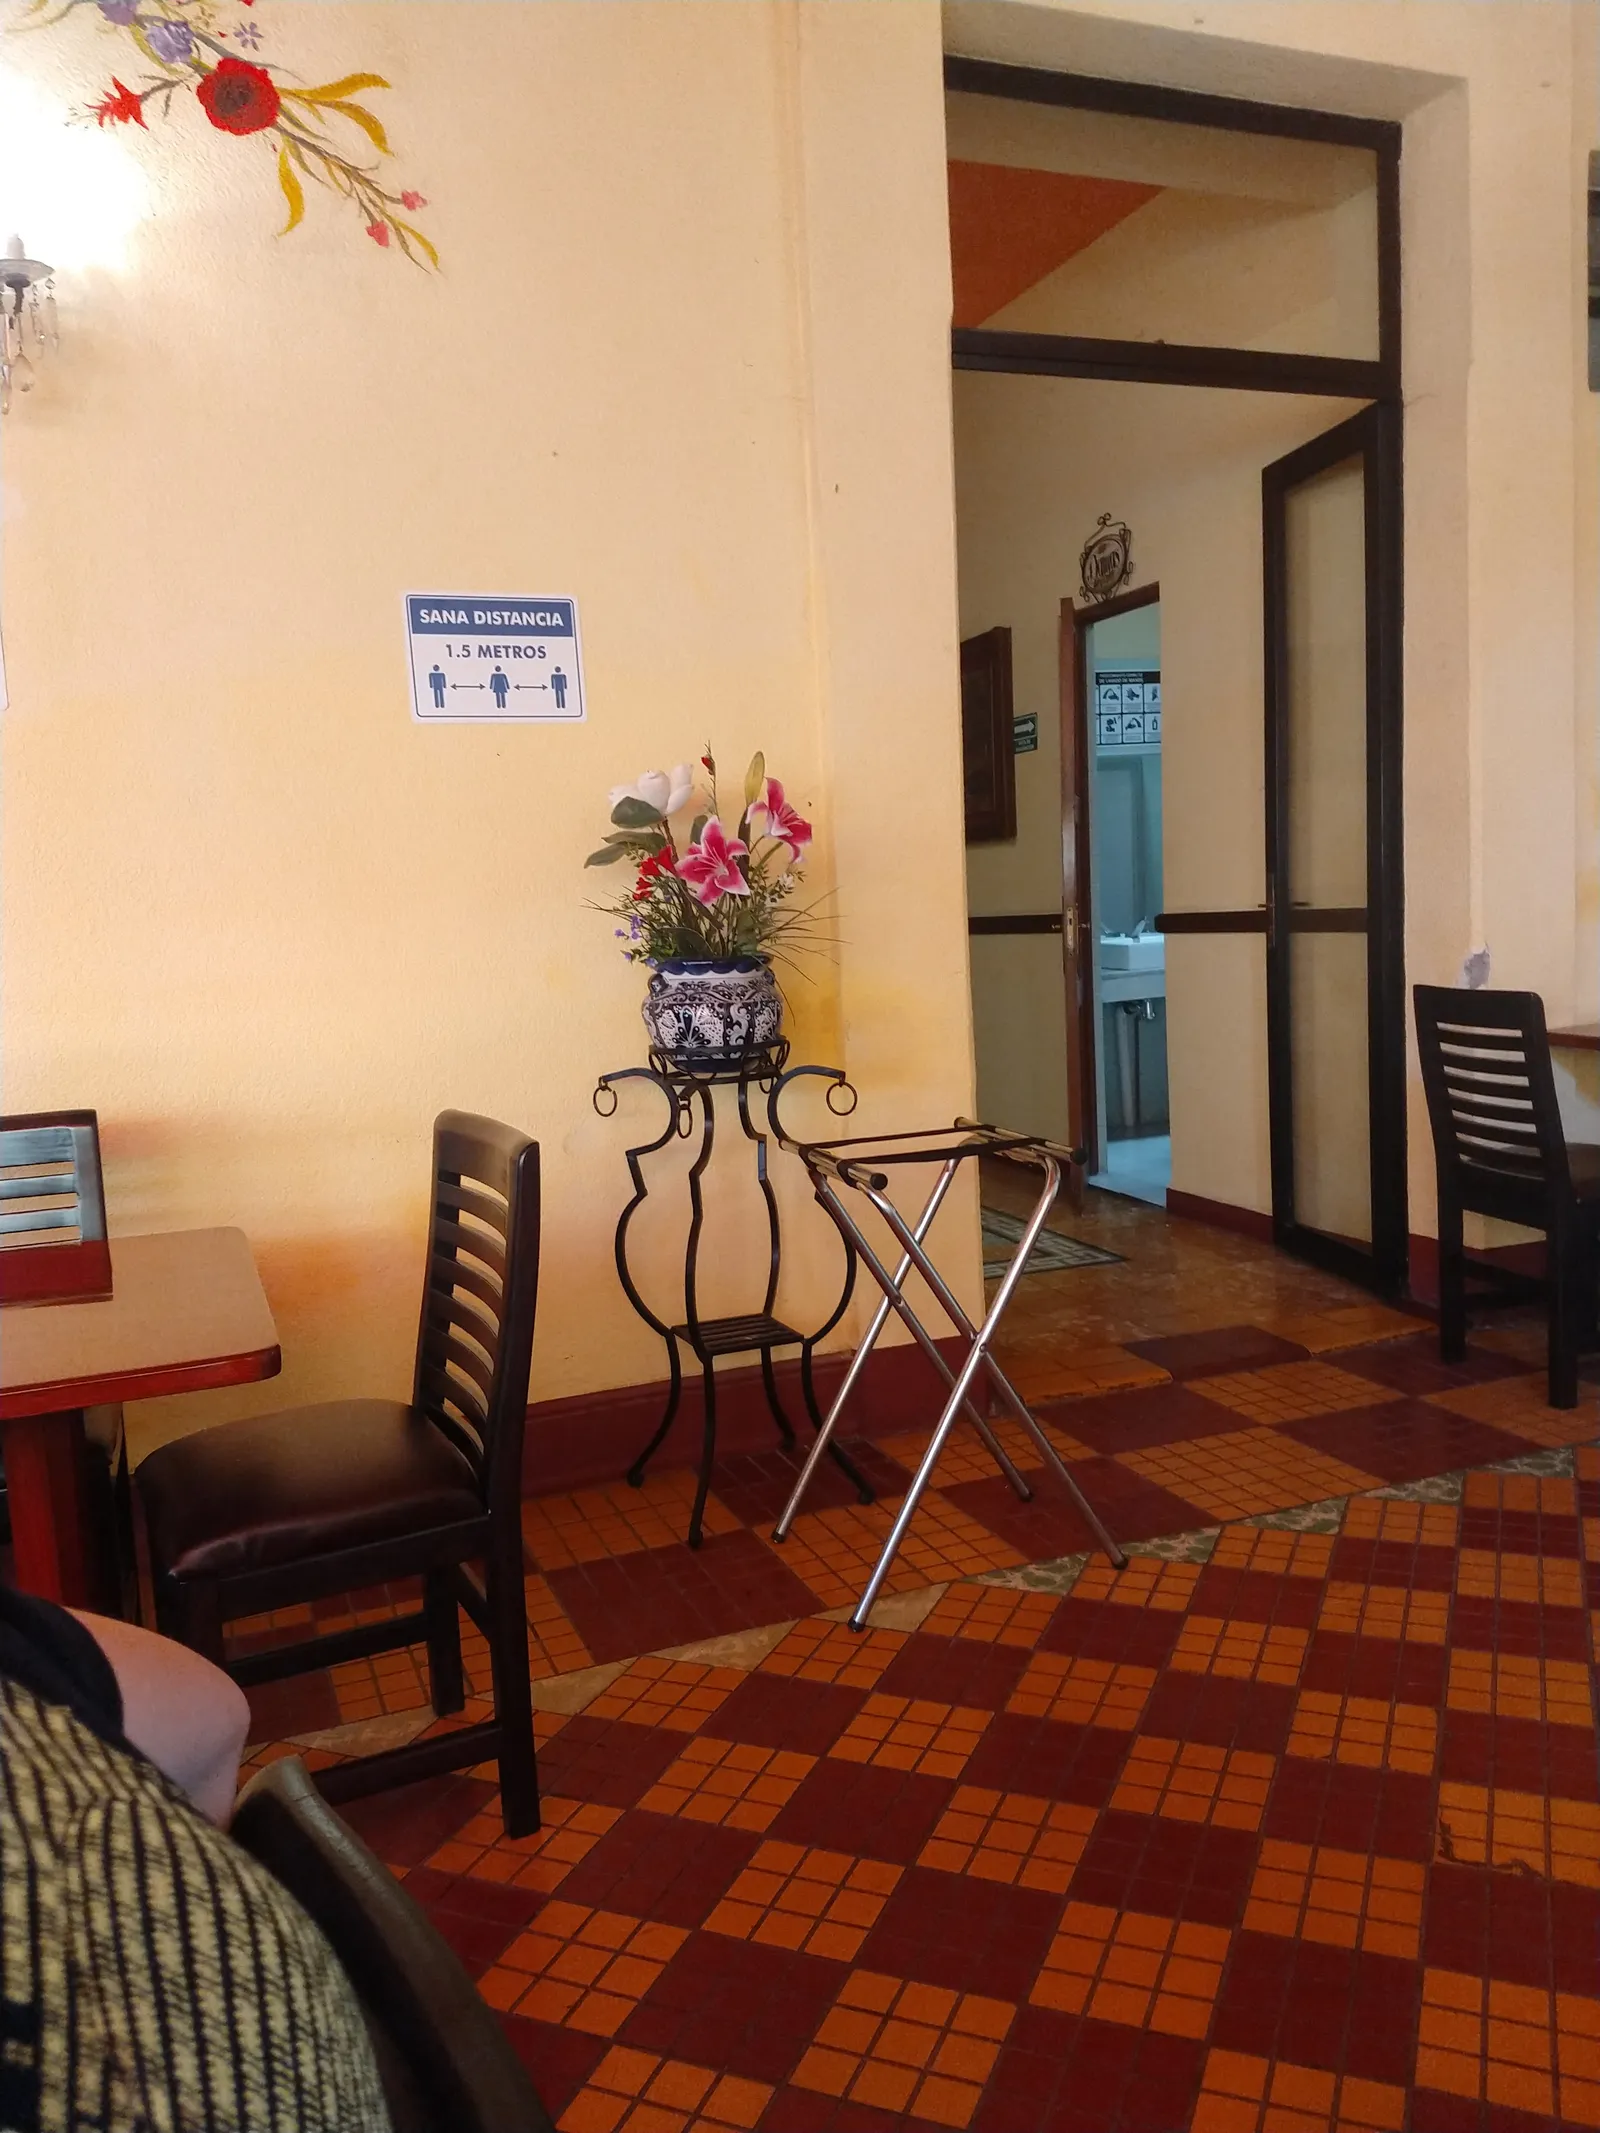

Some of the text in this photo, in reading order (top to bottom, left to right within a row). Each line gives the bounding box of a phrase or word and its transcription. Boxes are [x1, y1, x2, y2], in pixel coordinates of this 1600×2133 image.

[419, 609, 565, 627] SANA DISTANCIA
[446, 644, 547, 660] 1.5 METROS
